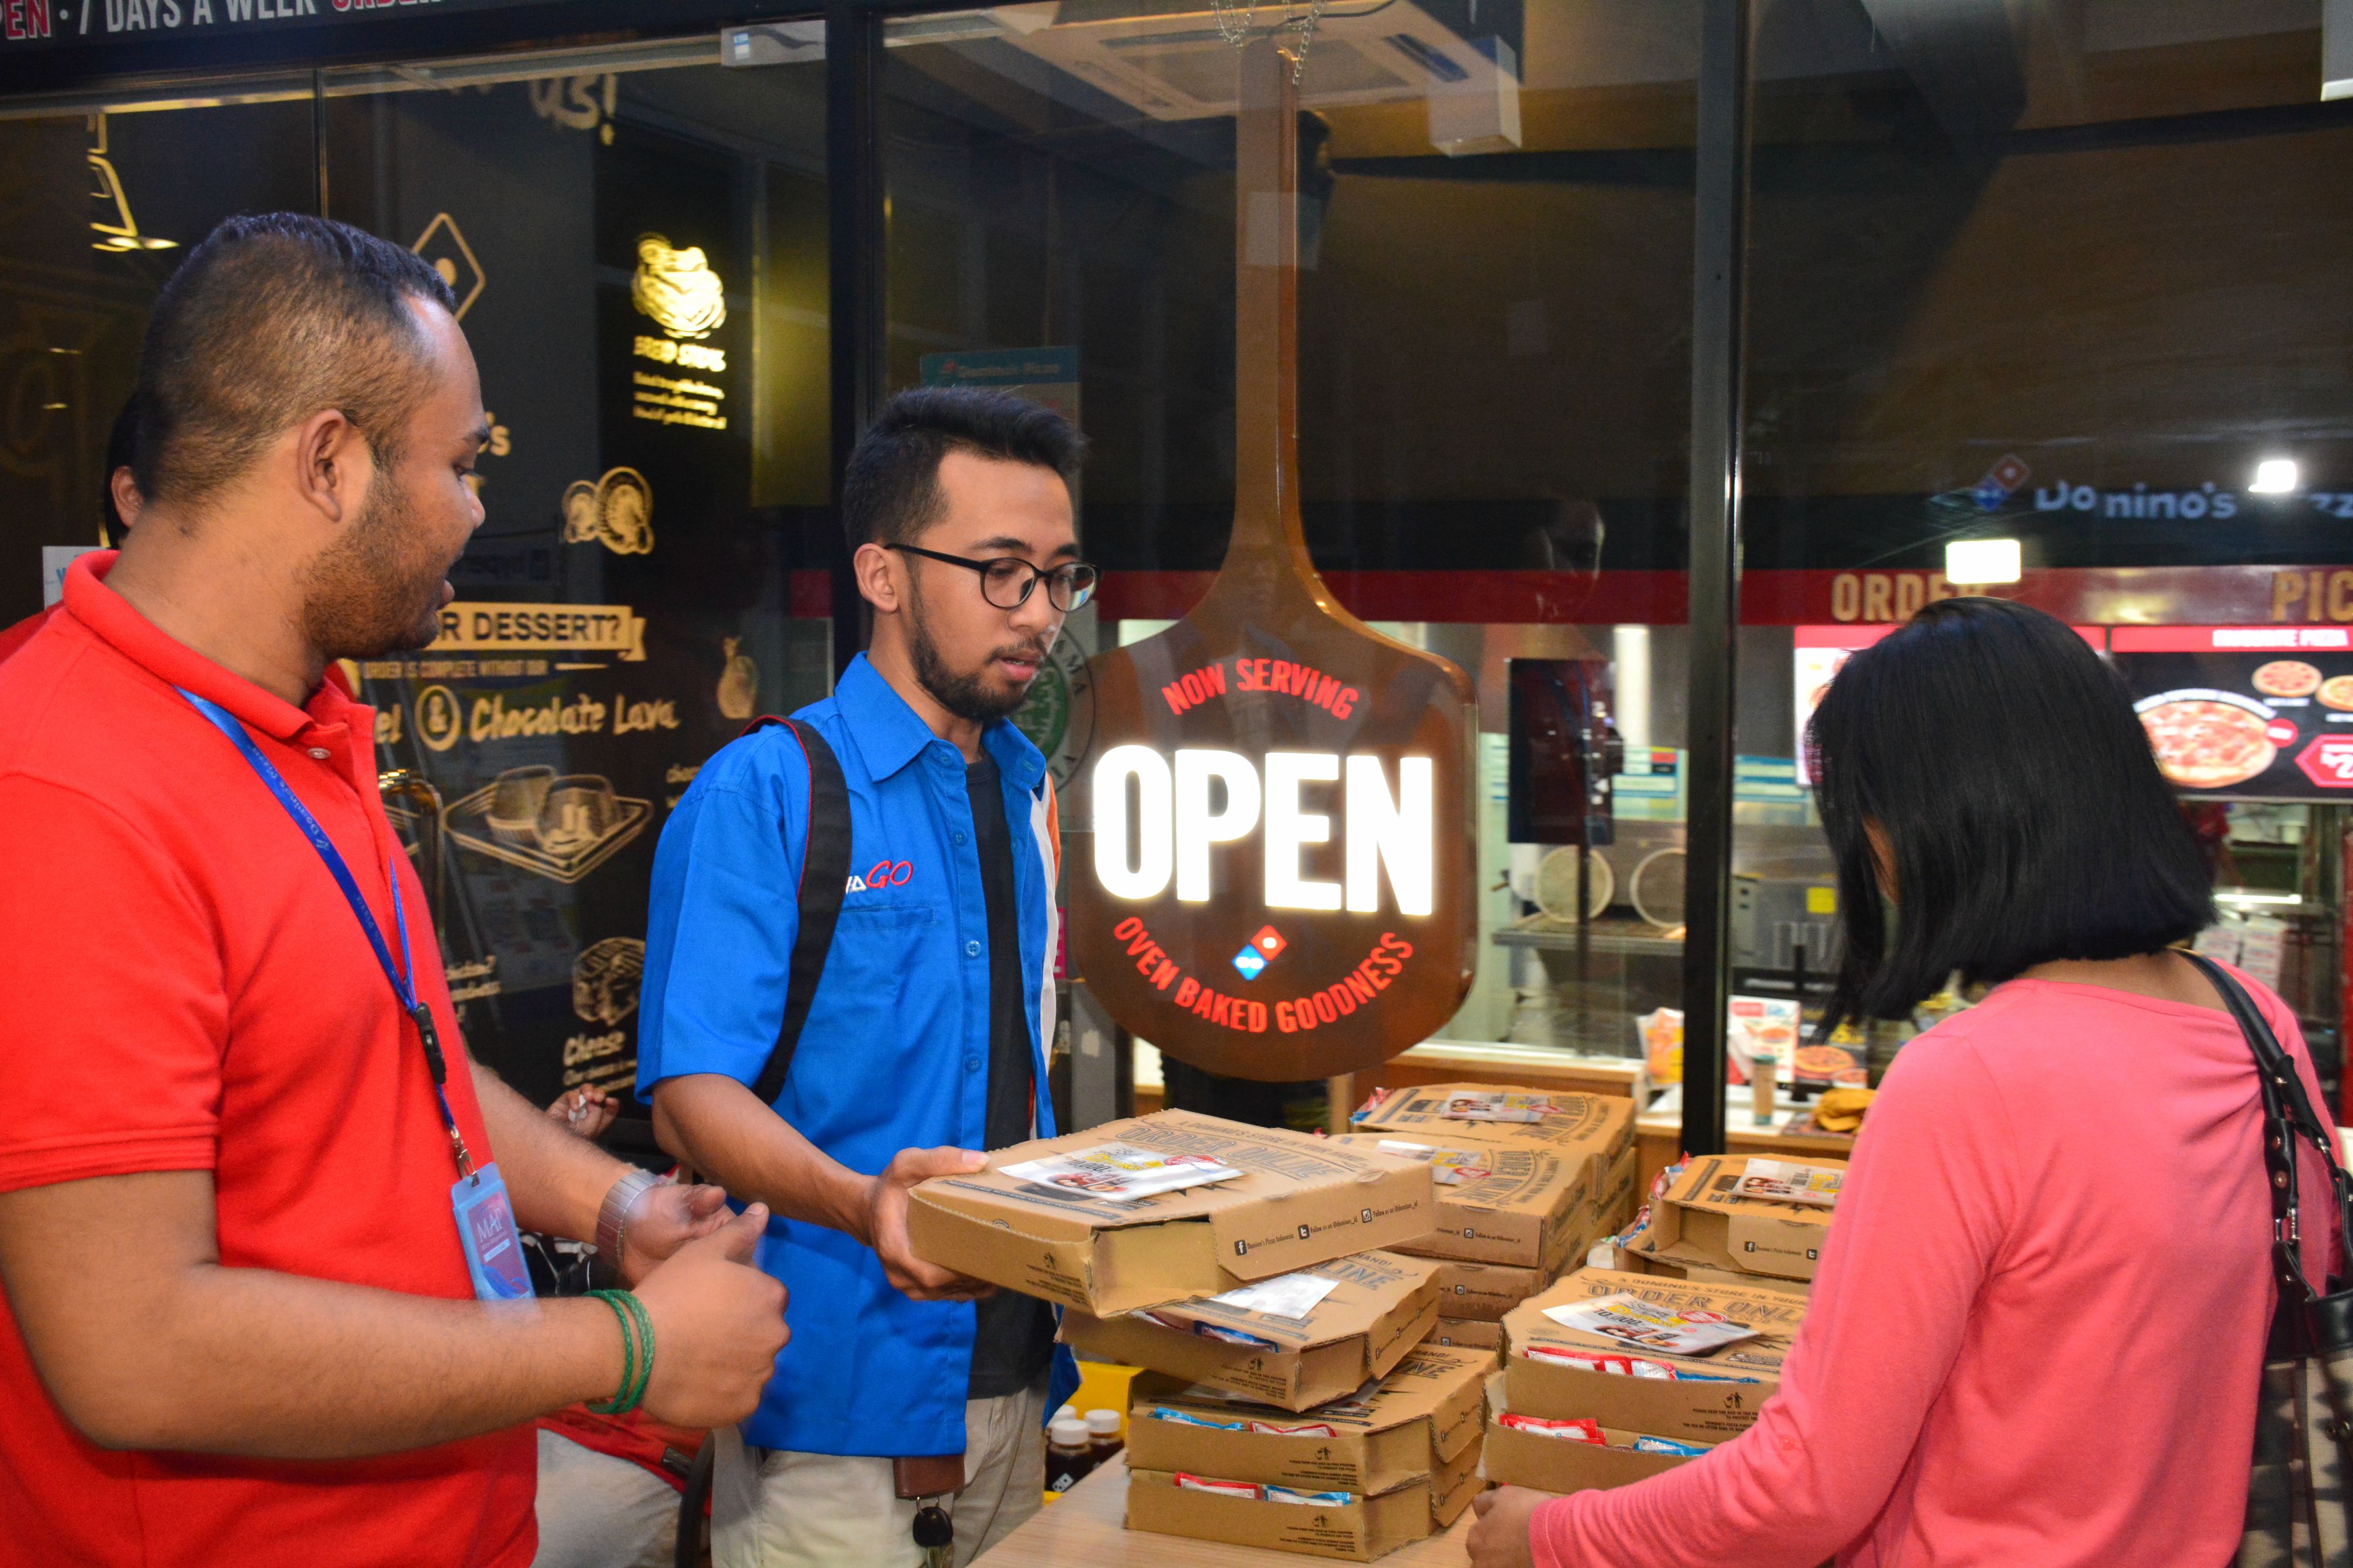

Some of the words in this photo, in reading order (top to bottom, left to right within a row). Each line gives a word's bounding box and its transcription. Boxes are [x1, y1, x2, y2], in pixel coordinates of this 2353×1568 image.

[0, 0, 51, 39] EN
[106, 0, 181, 32] DAYS
[193, 0, 212, 25] A
[1831, 573, 1986, 622] ORD
[474, 612, 621, 640] DESSERT?
[1161, 663, 1226, 715] NOW
[1236, 658, 1358, 720] SERVING
[470, 693, 606, 742] Chocolate
[612, 693, 681, 735] Lava
[1094, 745, 1432, 916] OPEN
[1114, 916, 1180, 991] OVEN
[1174, 977, 1267, 1033] BAKED
[1276, 932, 1413, 1033] GOODNESS
[1116, 1127, 1236, 1153] ORDER
[1227, 1146, 1345, 1178] ONLINE
[1315, 1262, 1397, 1290] LINE
[1354, 1253, 1393, 1266] HAND!
[1632, 1279, 1699, 1291] DOMINO'S
[1724, 1300, 1801, 1324] ONL
